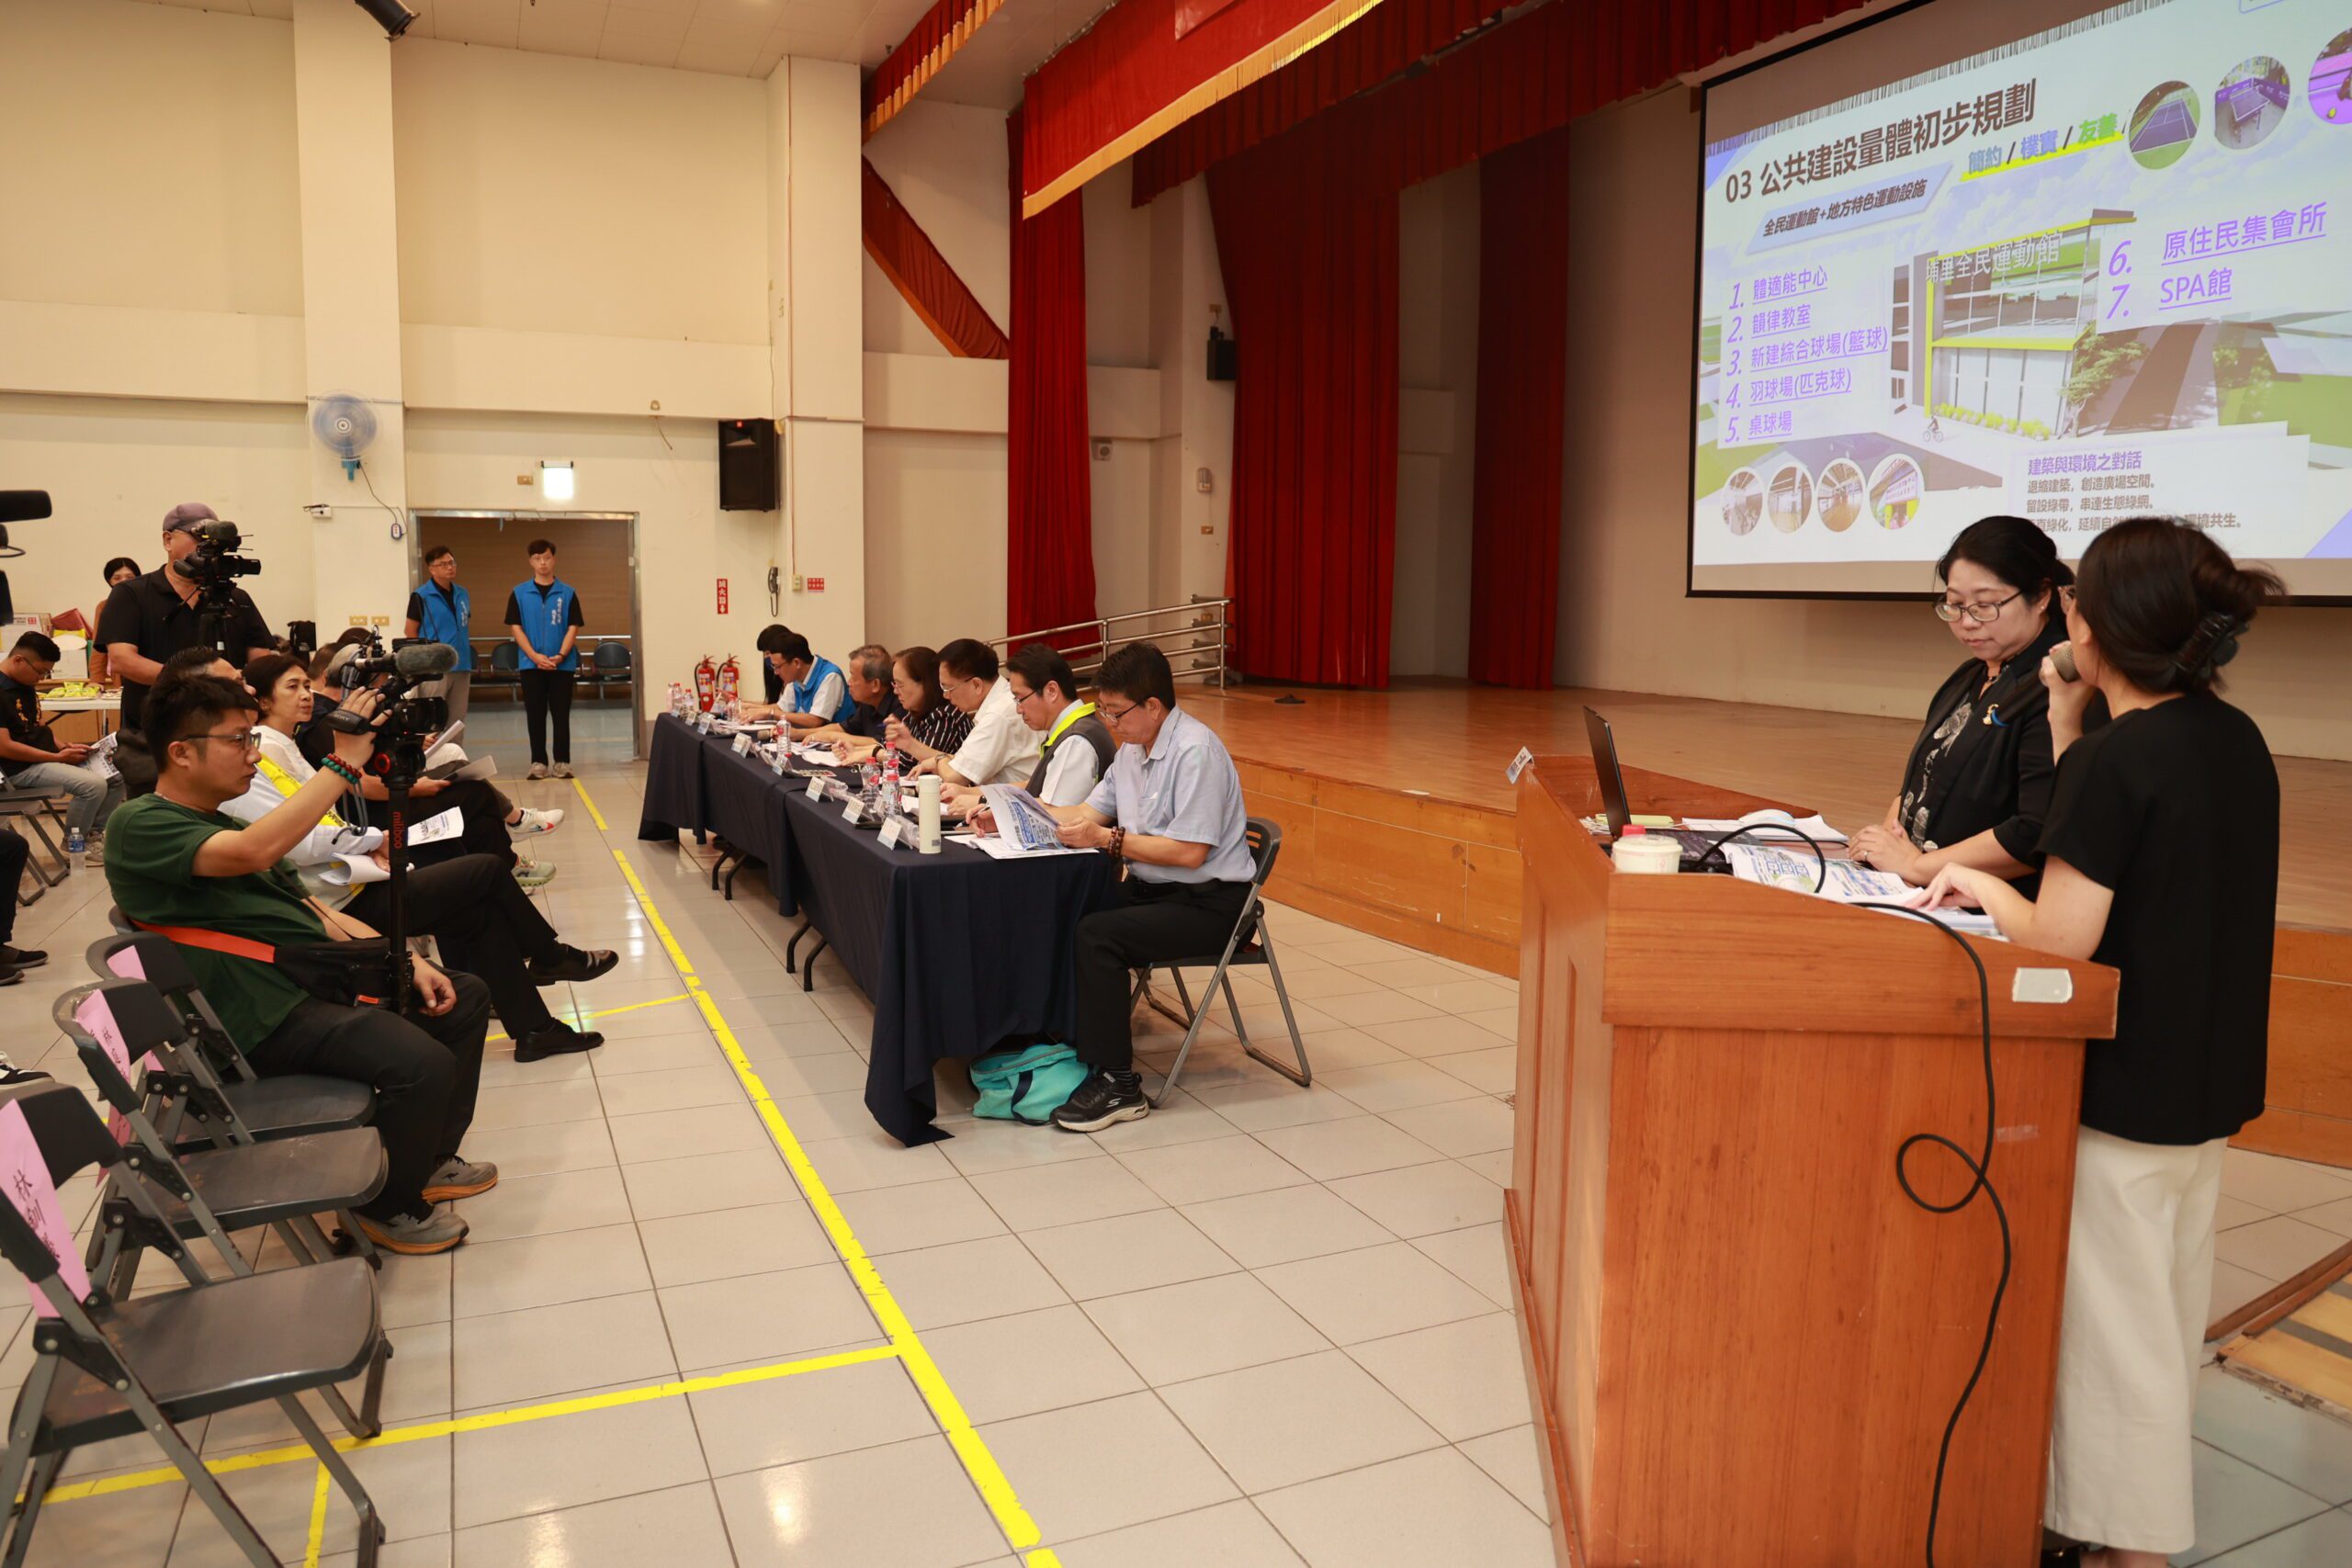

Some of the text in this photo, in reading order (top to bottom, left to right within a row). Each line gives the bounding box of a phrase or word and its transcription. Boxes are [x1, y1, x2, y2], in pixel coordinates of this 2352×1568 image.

[1725, 77, 2037, 203] 03 公共建設量體初步規劃
[1969, 145, 2003, 175] 簡約
[2021, 130, 2059, 161] 樸實
[2078, 112, 2118, 144] 友善
[1763, 177, 1928, 237] 全民運動館+地方特色運動設施
[2109, 201, 2327, 276] 6. 原住民集會所
[1729, 265, 1827, 310] 1. 體適能中心
[2106, 266, 2233, 320] 7. SPA館
[1727, 304, 1811, 344] 2. 韻律教室
[1726, 327, 1888, 377] 3. 新建綜合球場(籃球)
[1726, 367, 1851, 409] 4. 羽球場(匹克球)
[1724, 411, 1792, 443] 5. 桌球場
[2028, 451, 2143, 476] 建築與環境之對話
